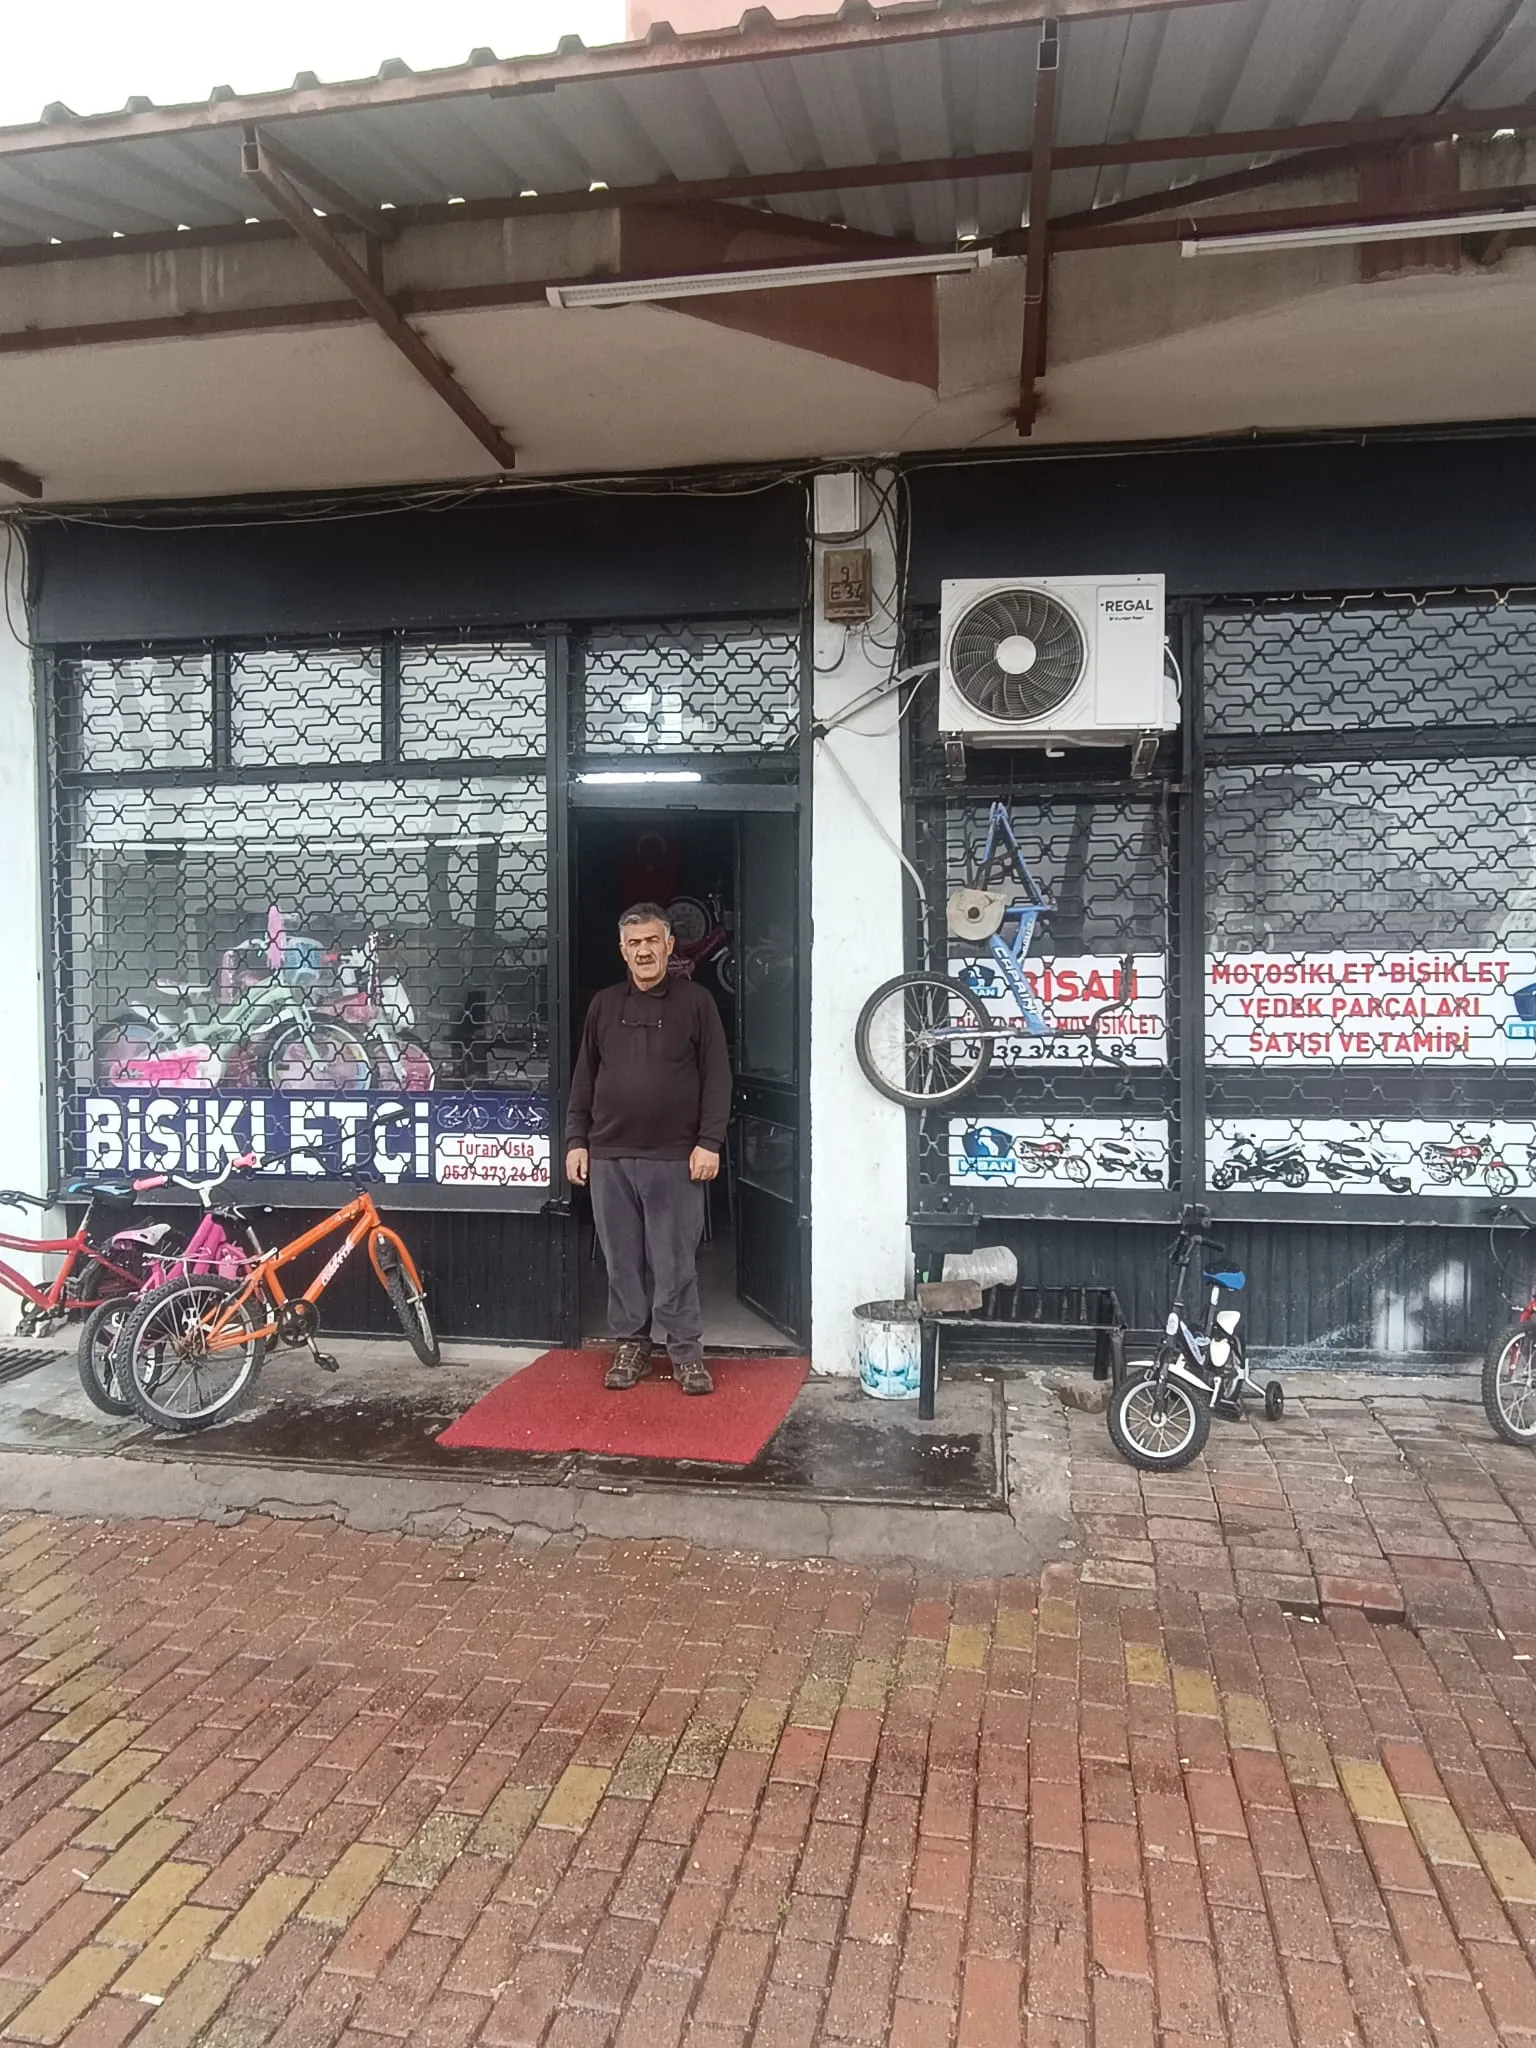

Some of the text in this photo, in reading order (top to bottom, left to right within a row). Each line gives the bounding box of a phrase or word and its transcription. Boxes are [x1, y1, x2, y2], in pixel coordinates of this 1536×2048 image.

[1105, 599, 1154, 612] REGAL
[1239, 997, 1480, 1020] YEDEK PARÇALARI
[1249, 1026, 1470, 1055] SATIŞI VE TAMİRİ
[457, 1140, 534, 1157] Turan Usta
[481, 1165, 506, 1181] 373
[510, 1166, 527, 1182] 26
